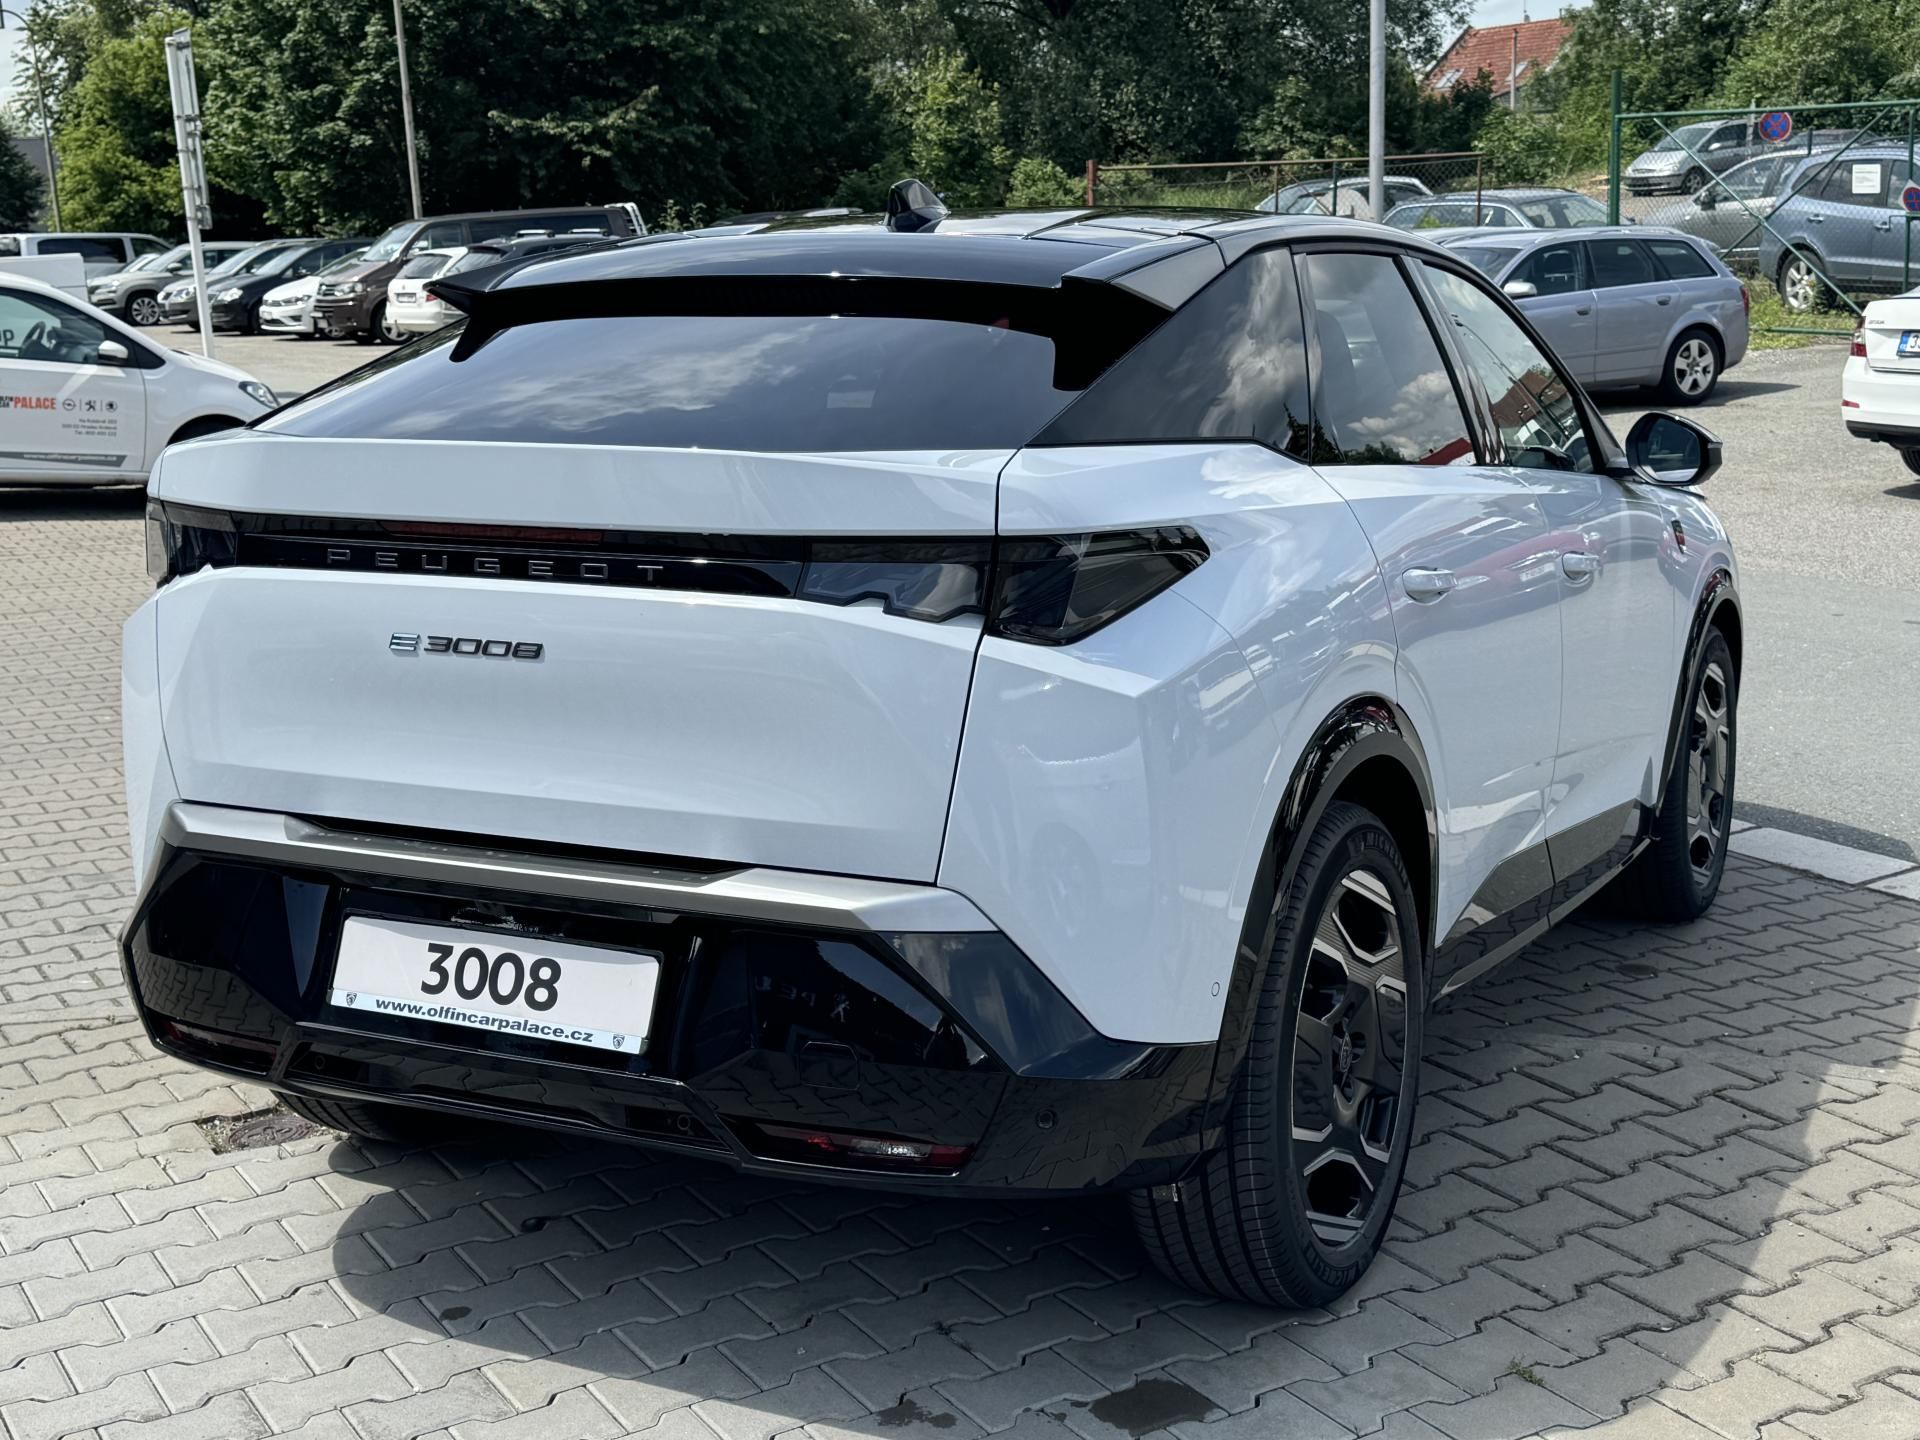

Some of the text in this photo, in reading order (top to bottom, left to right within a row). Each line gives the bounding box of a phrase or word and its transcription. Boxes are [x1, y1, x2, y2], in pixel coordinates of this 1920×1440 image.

[14, 396, 57, 410] PALACE
[327, 548, 664, 582] PEUGEOT
[420, 942, 562, 1012] 3008
[375, 998, 594, 1043] www.olfincarpalace.cz
